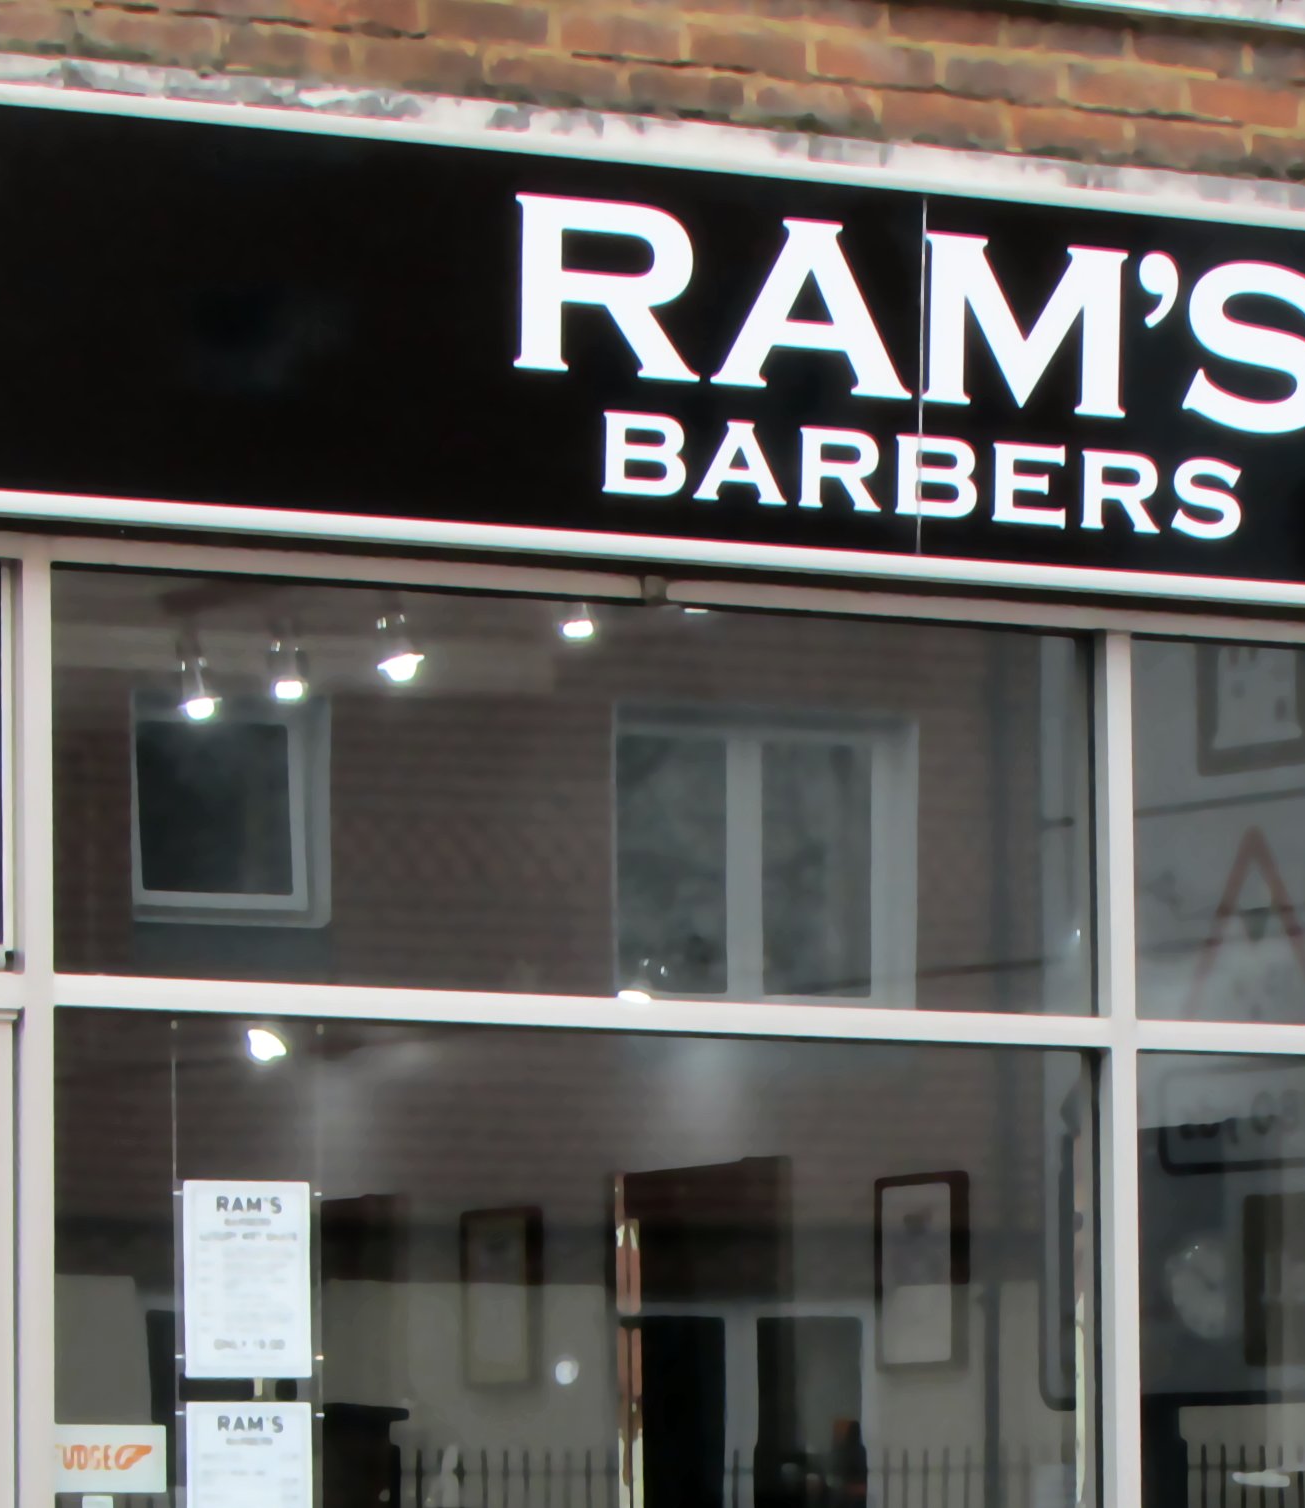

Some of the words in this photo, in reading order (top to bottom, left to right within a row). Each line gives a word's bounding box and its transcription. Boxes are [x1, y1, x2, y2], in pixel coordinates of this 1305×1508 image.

[601, 410, 1243, 540] BARBERS
[215, 1195, 283, 1214] RAM'S
[217, 1415, 285, 1433] RAM'S
